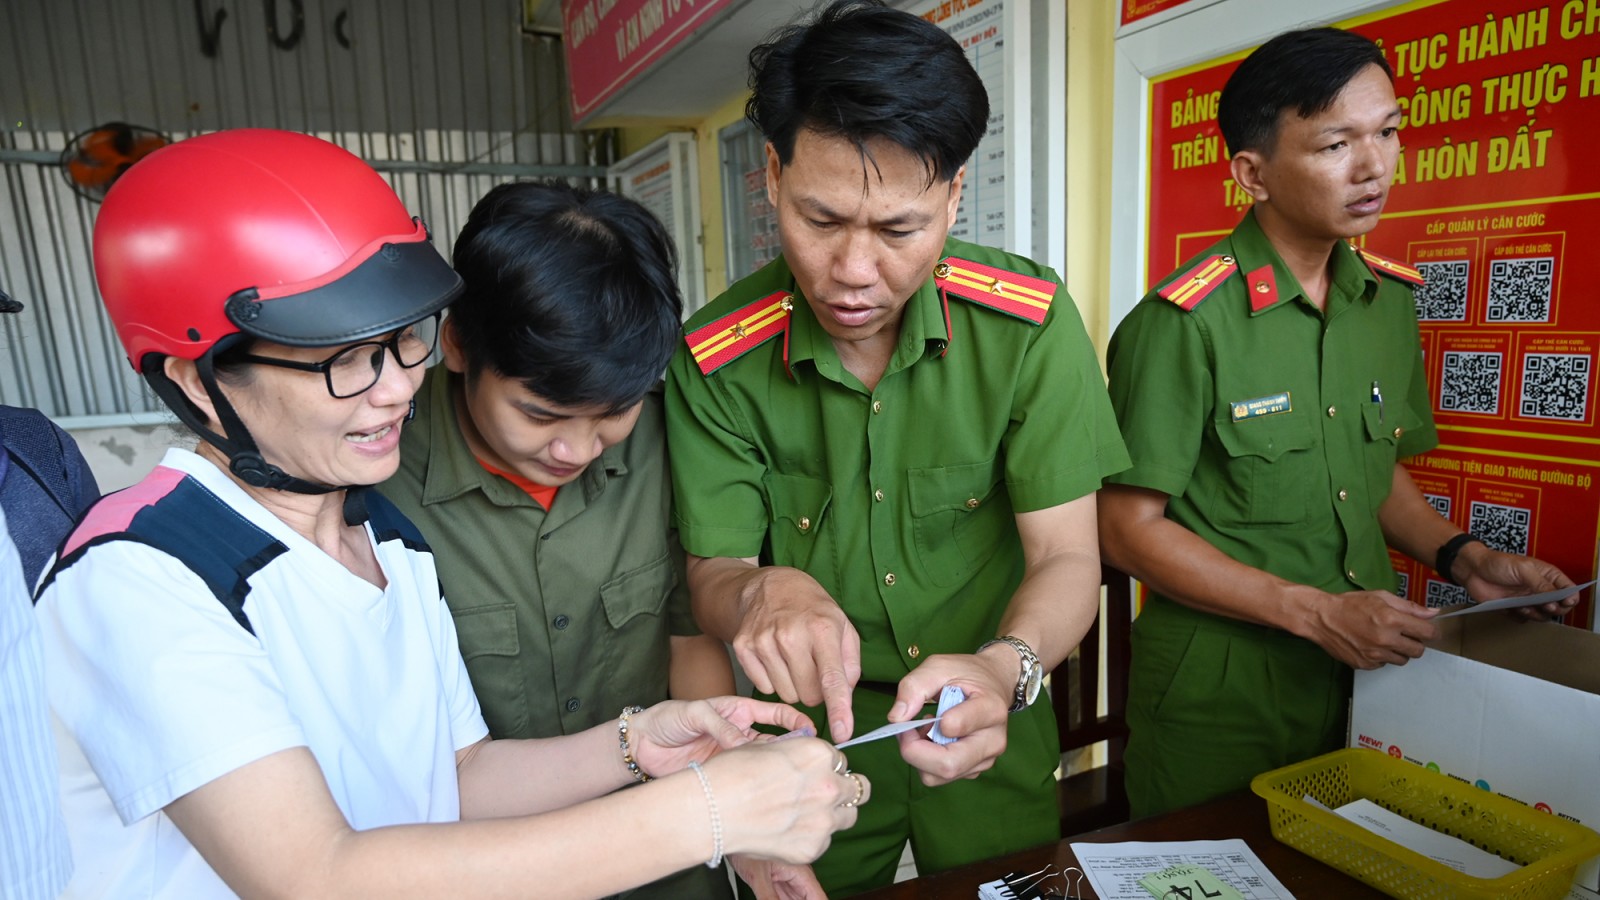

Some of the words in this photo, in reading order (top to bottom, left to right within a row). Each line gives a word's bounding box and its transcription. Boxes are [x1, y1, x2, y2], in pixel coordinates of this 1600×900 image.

[1171, 88, 1221, 129] BẢNG
[1394, 33, 1448, 81] TỤC
[1457, 7, 1549, 64] HÀNH
[1171, 133, 1219, 170] TRÊN
[1396, 86, 1472, 131] CÔNG
[1482, 63, 1568, 116] THỰC
[1416, 137, 1478, 183] HÒN
[1487, 118, 1553, 173] ĐẤT
[1426, 220, 1446, 235] CẤP
[1448, 217, 1475, 233] QUẢN
[1477, 215, 1488, 231] LÝ
[1491, 215, 1513, 230] CĂN
[1516, 213, 1546, 228] CƯỚC
[1463, 460, 1482, 475] TIỆN
[1484, 463, 1505, 477] GIAO
[1507, 465, 1538, 481] THÔNG
[1577, 473, 1591, 491] BỘ
[1358, 734, 1383, 749] NEW!
